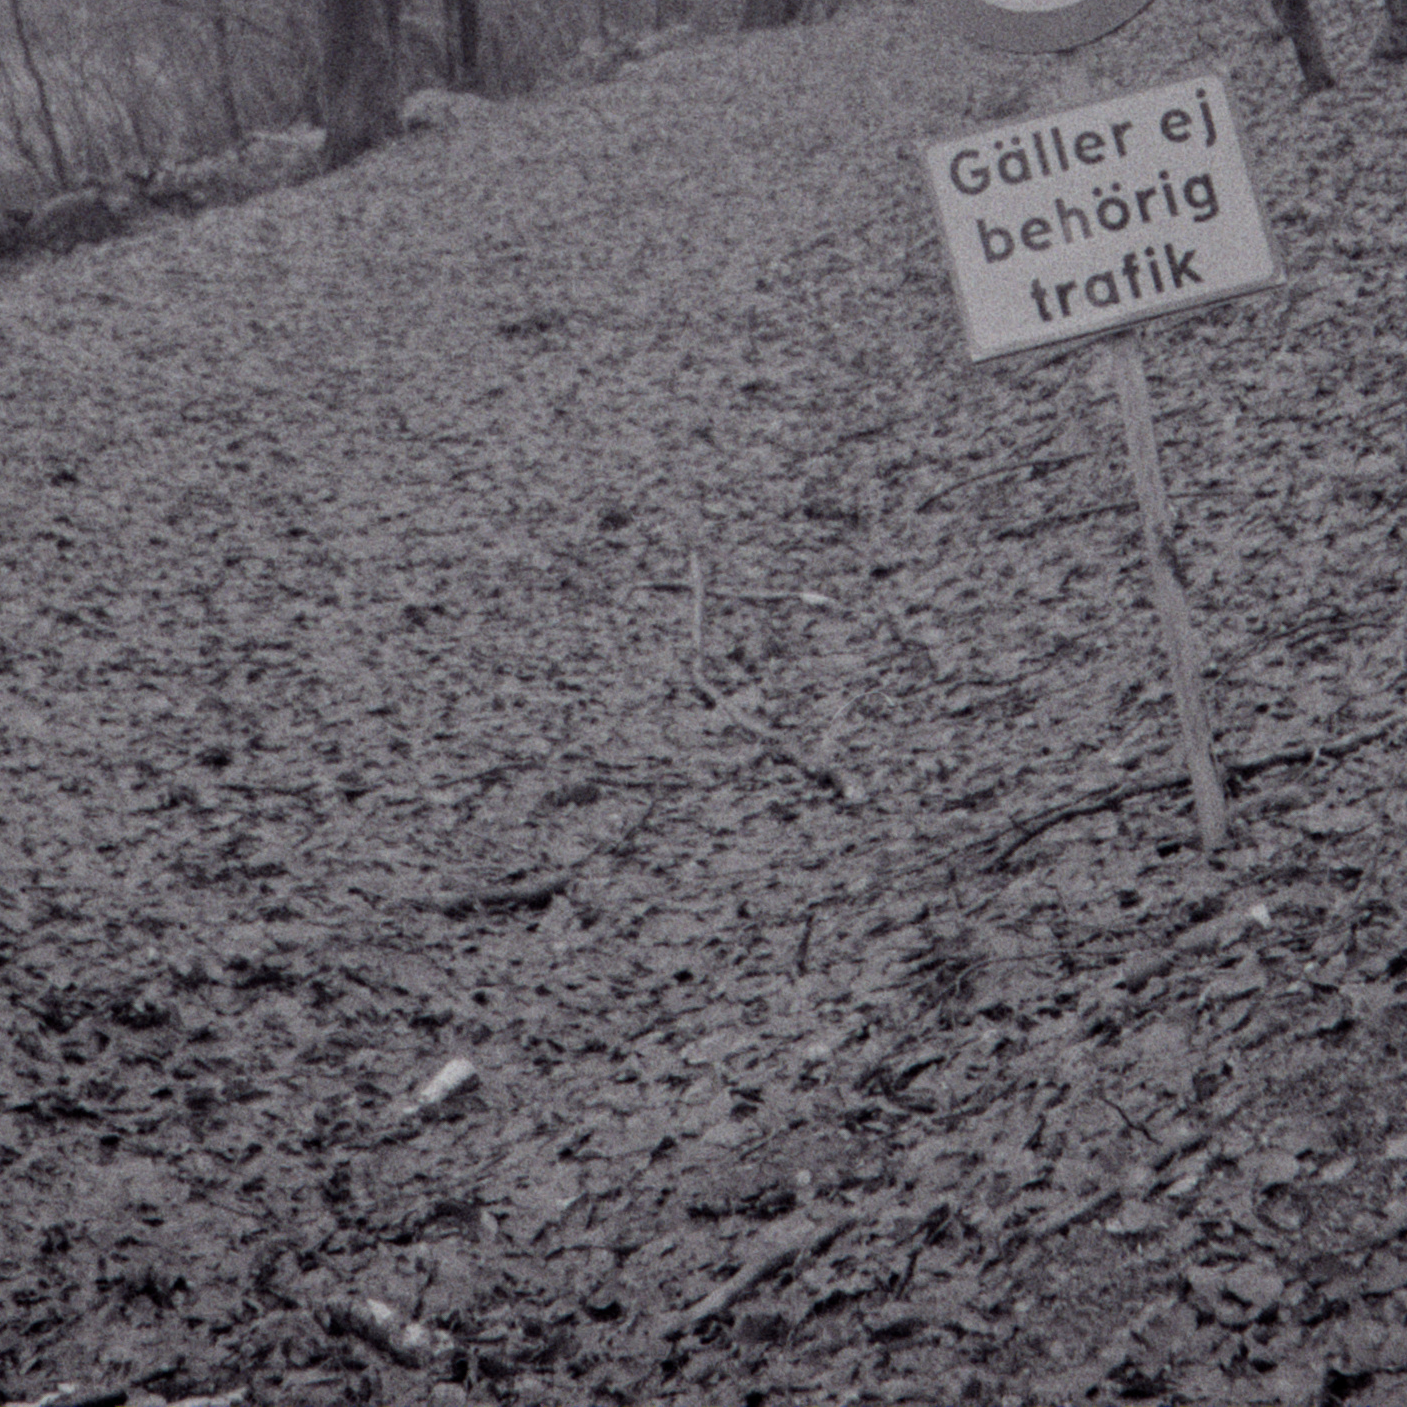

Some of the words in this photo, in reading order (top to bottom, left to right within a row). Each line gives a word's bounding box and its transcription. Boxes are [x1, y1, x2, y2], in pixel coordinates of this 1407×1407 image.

[949, 120, 1134, 196] Gäller
[1160, 87, 1217, 148] ej
[976, 169, 1220, 264] behörig
[1029, 242, 1205, 323] trafik
